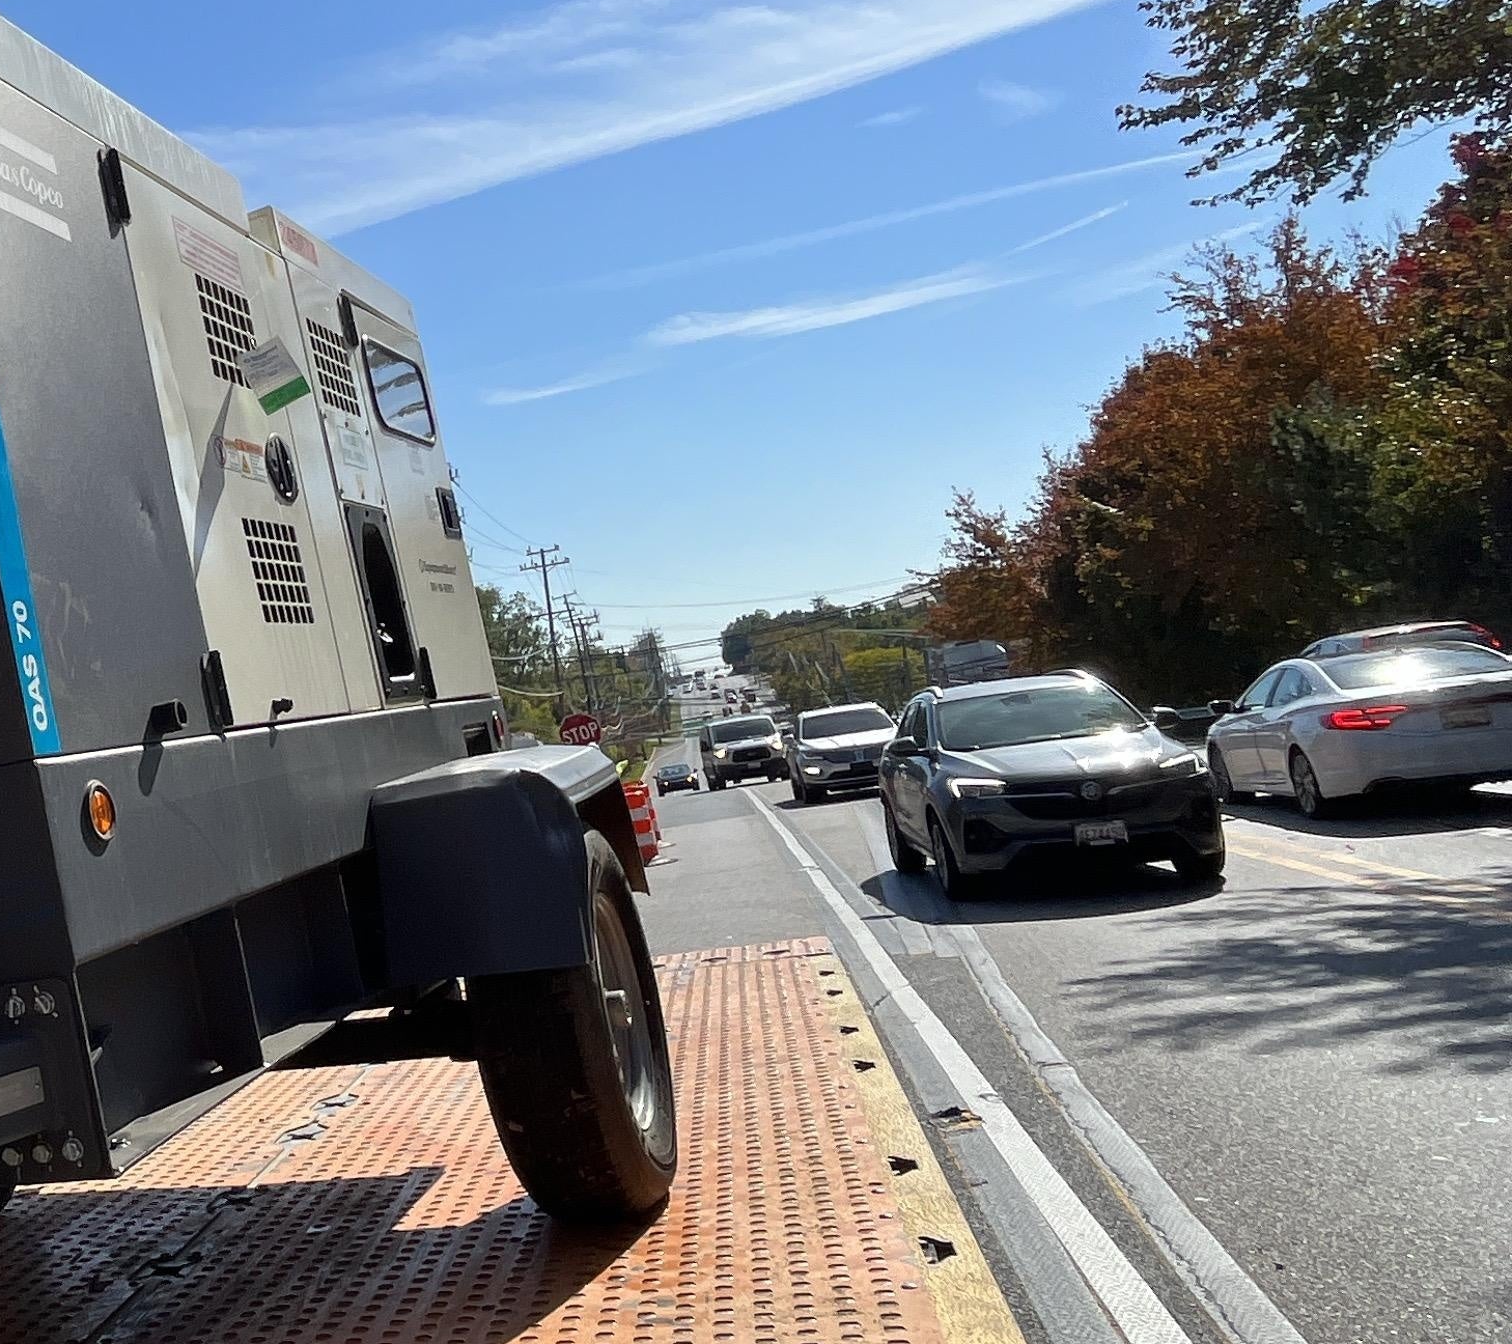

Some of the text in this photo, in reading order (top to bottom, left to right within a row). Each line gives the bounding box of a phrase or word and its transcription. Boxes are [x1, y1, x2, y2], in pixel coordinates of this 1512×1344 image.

[20, 165, 64, 209] Copco
[12, 600, 32, 644] 70
[562, 722, 598, 745] STOP
